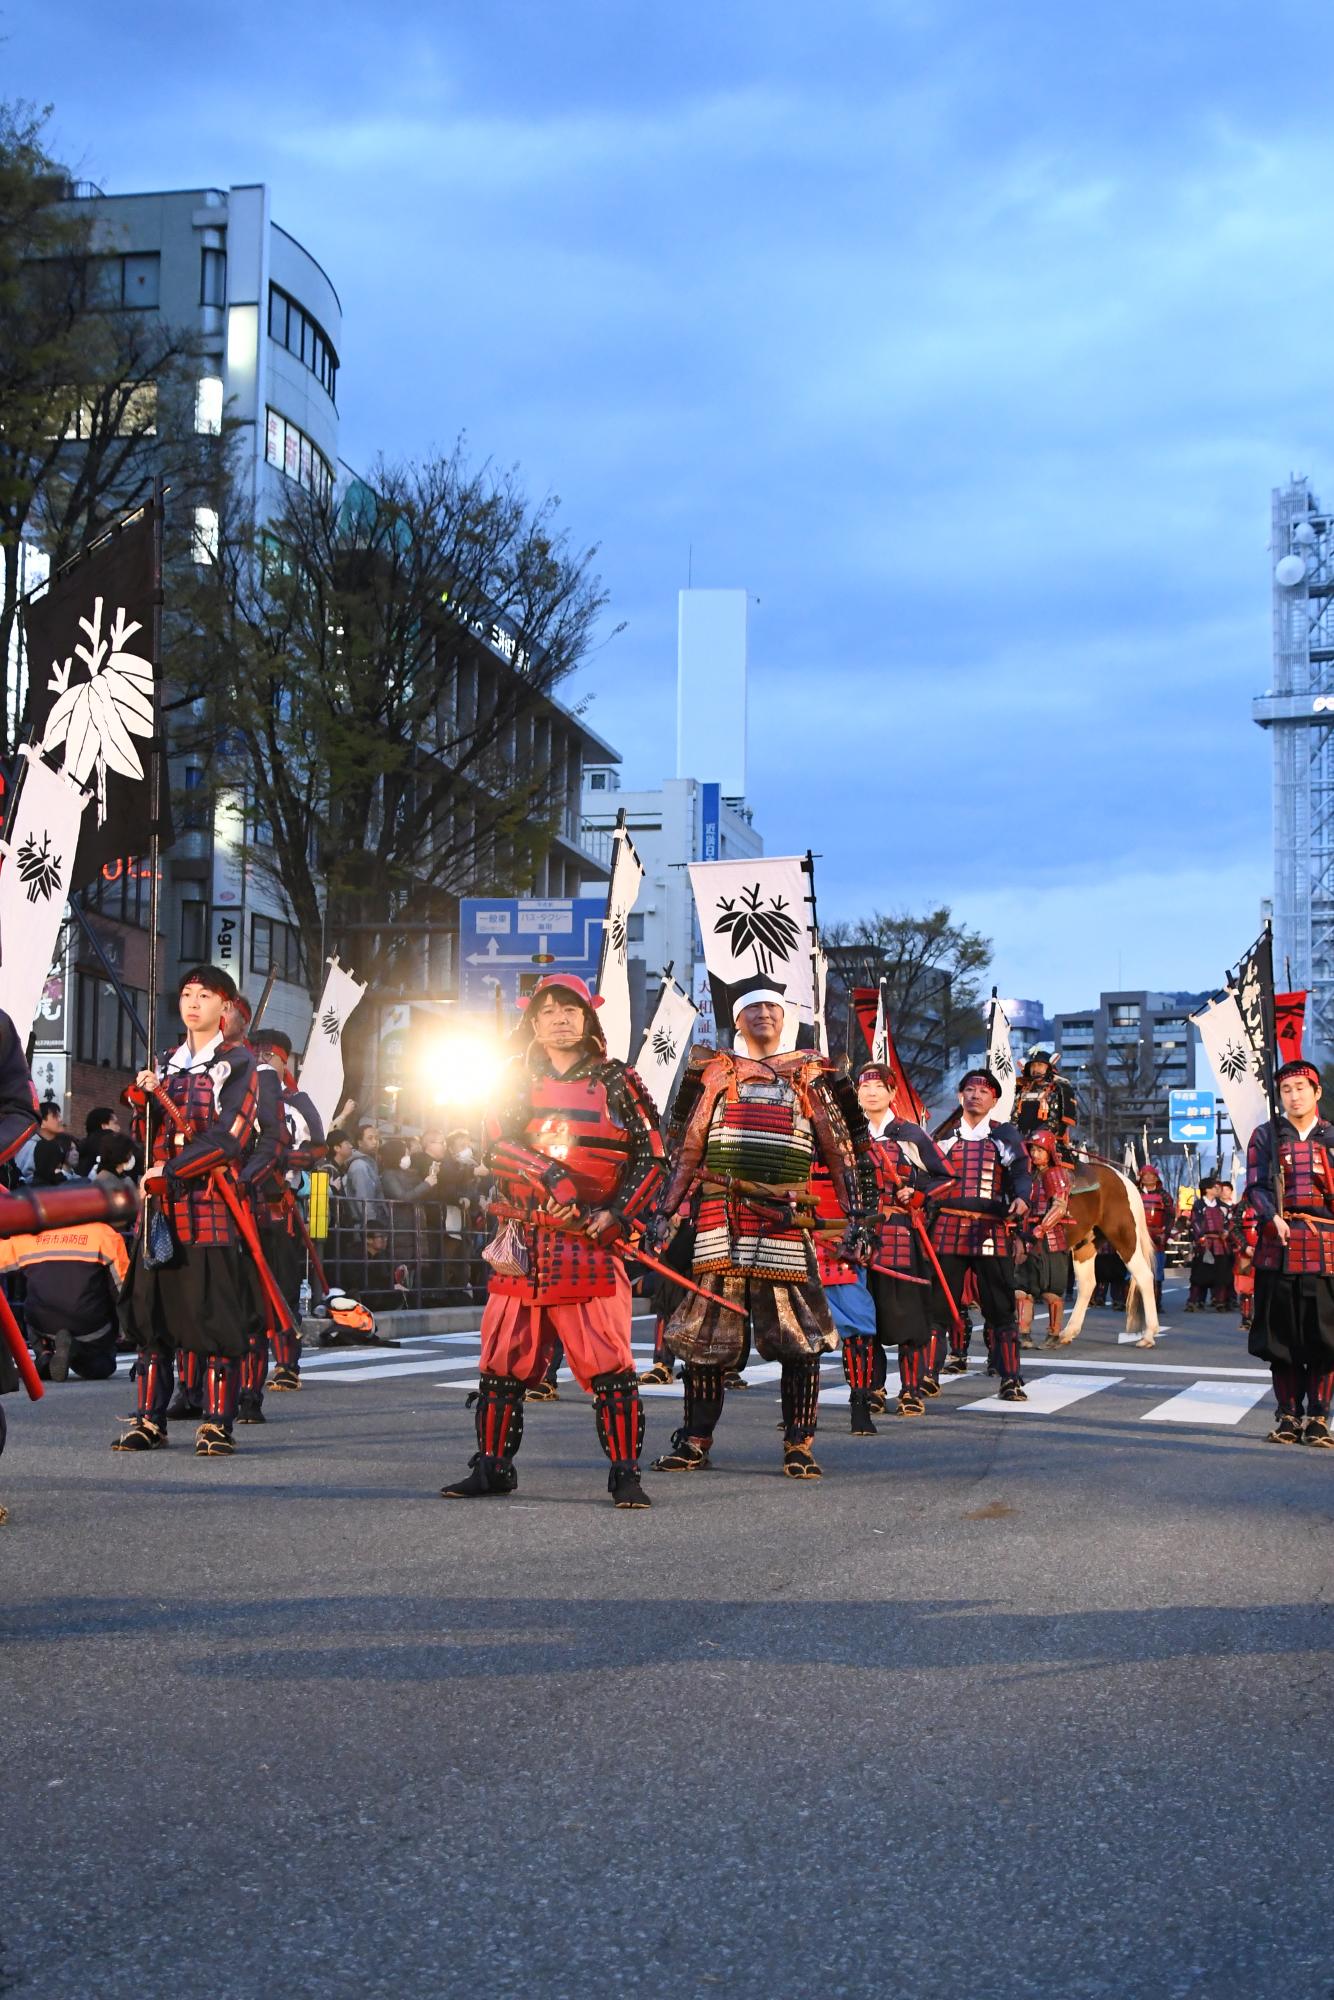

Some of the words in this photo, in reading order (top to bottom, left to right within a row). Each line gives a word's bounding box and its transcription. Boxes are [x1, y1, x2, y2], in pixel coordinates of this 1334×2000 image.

[218, 917, 236, 959] Agu
[36, 1233, 88, 1246] 甲府市消防団
